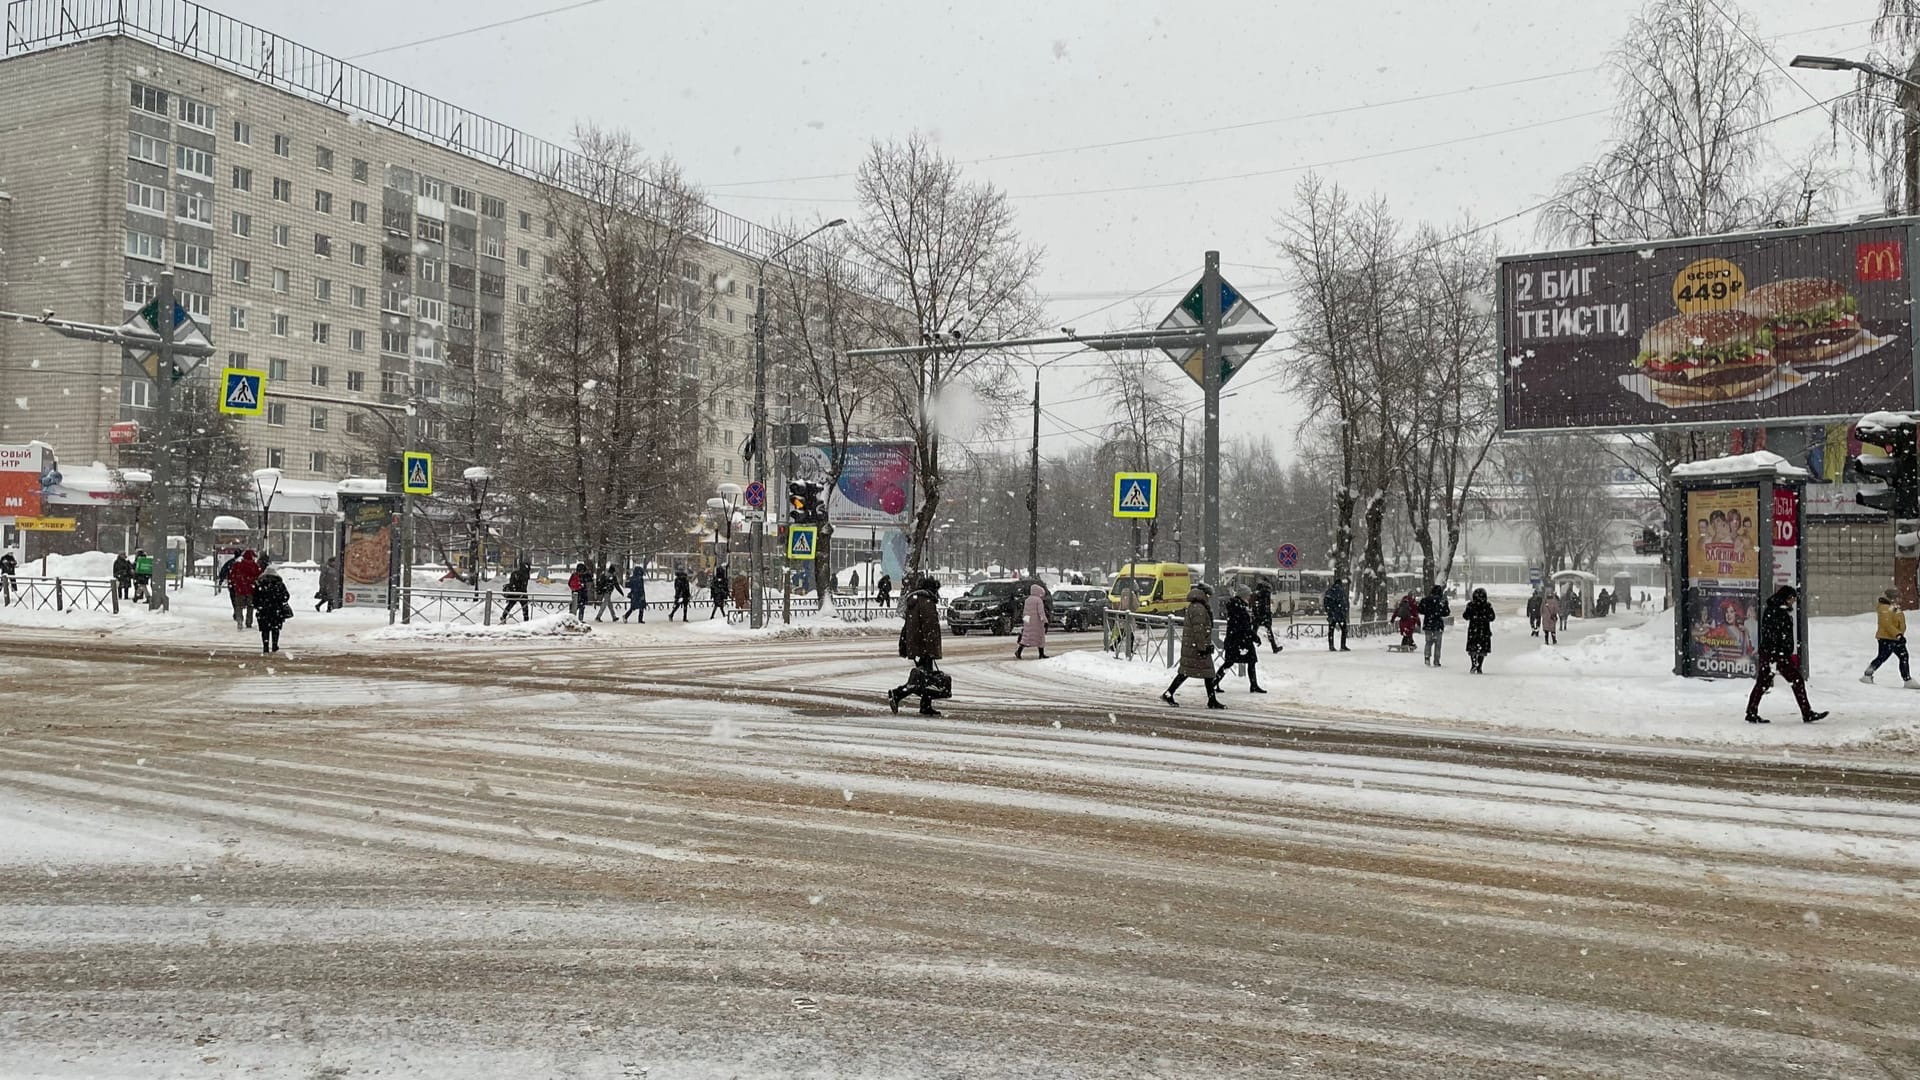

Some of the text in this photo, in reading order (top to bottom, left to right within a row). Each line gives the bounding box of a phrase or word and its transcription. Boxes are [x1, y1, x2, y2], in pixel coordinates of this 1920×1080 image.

[1518, 266, 1597, 301] 2 БИГ
[1686, 268, 1731, 281] всего
[1517, 299, 1629, 339] ТЕЙСТИ
[1697, 658, 1757, 676] СЮРПРИЗ
